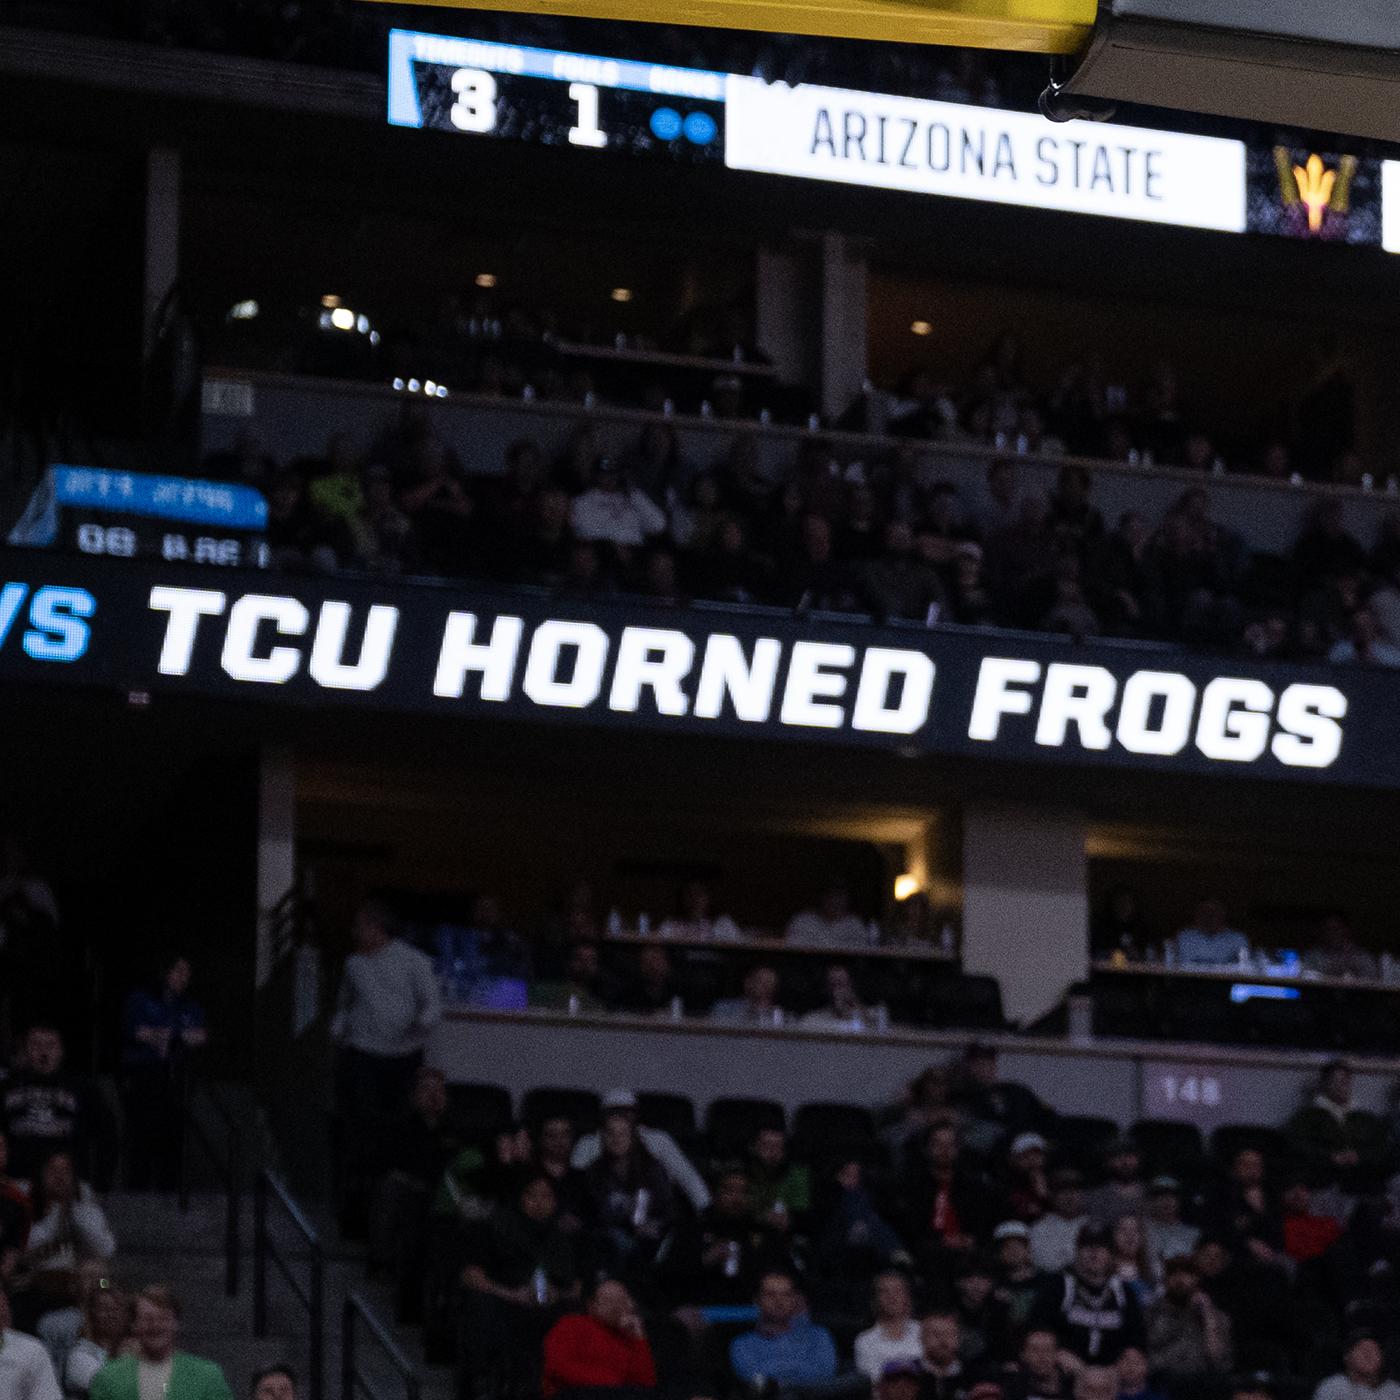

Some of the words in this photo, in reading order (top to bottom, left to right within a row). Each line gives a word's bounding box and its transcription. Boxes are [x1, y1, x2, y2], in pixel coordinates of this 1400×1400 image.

[450, 67, 498, 133] 3
[567, 81, 608, 148] 1
[810, 106, 1018, 182] ARIZONA
[1035, 138, 1166, 201] STATE
[149, 585, 400, 692] TCU
[433, 610, 936, 735] HORNED
[967, 656, 1348, 768] FROGS
